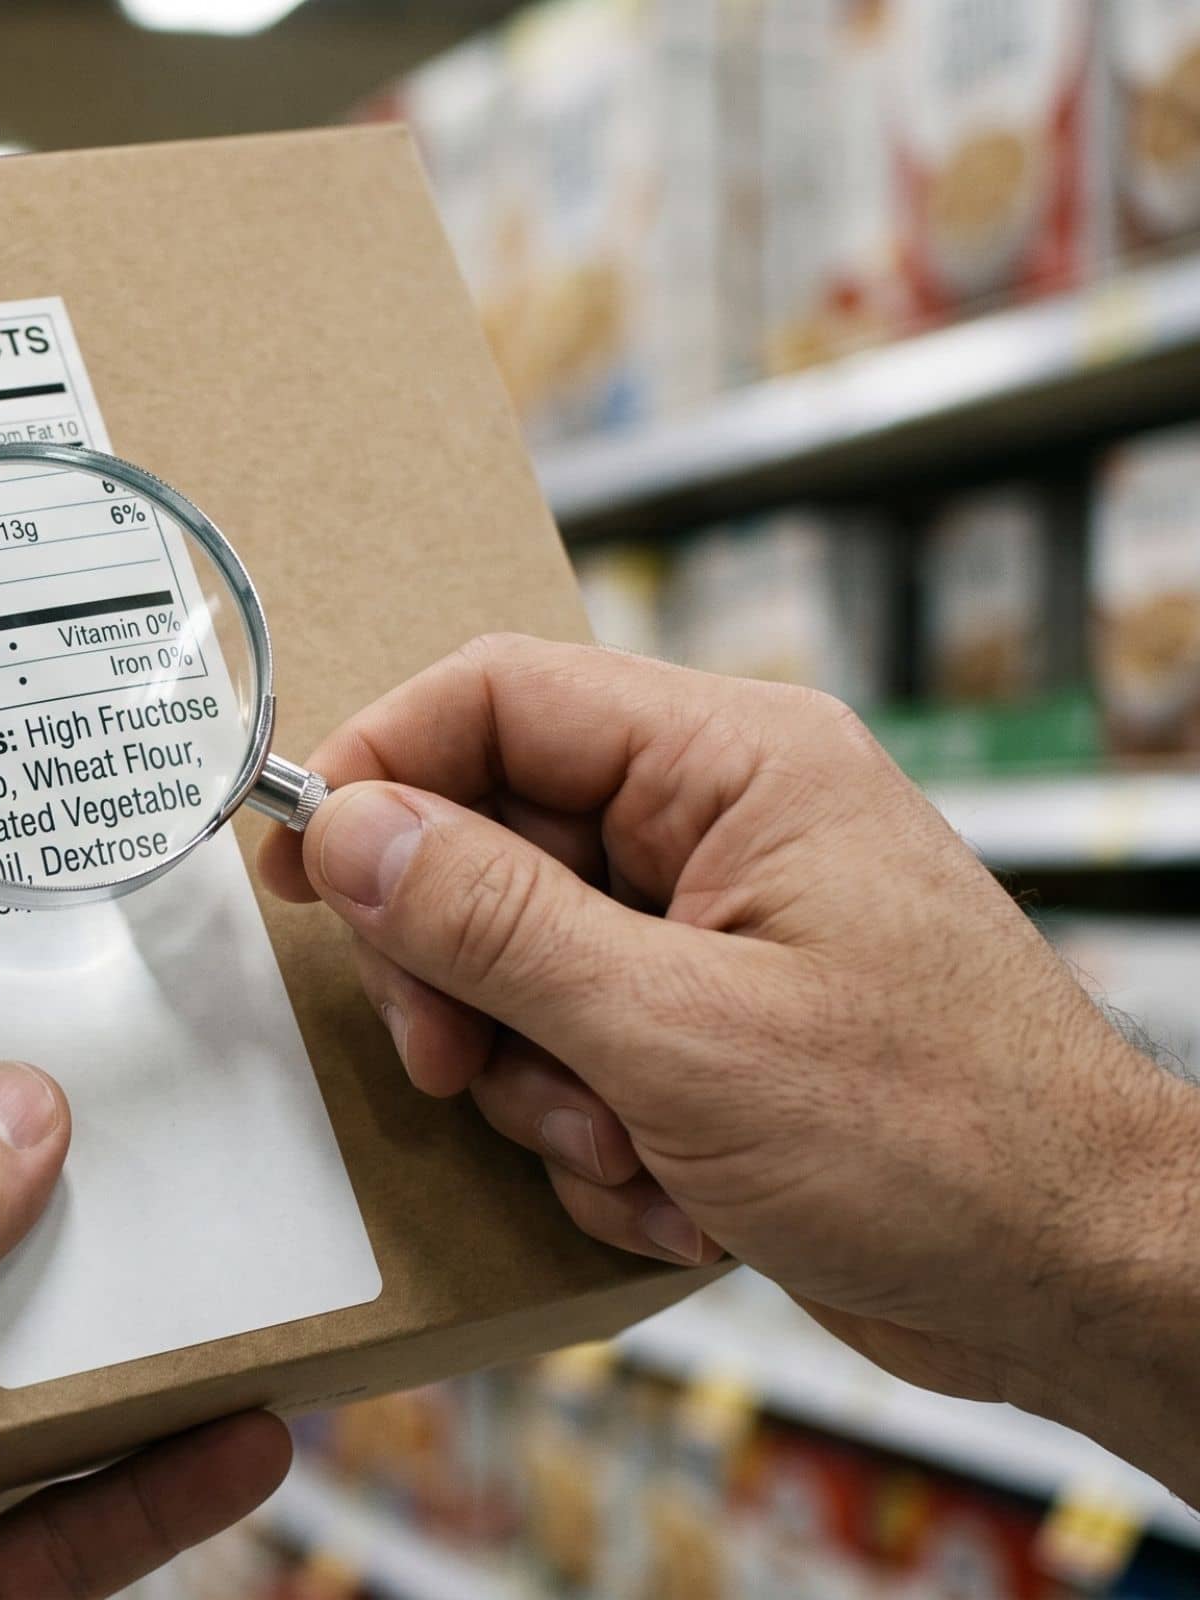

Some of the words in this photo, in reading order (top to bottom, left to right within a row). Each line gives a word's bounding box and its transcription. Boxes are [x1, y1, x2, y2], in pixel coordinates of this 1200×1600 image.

[26, 424, 54, 442] Fat
[58, 420, 80, 438] 10
[110, 503, 146, 525] 6%
[57, 618, 141, 648] Vitamin
[146, 610, 181, 636] 0%
[110, 654, 153, 676] Iron
[158, 646, 193, 668] 0%
[25, 710, 92, 750] High
[98, 695, 220, 736] Fructose
[22, 749, 118, 792] Wheat
[123, 741, 203, 774] Flour,
[61, 779, 202, 828] Vegetable
[40, 831, 169, 877] Dextrose
